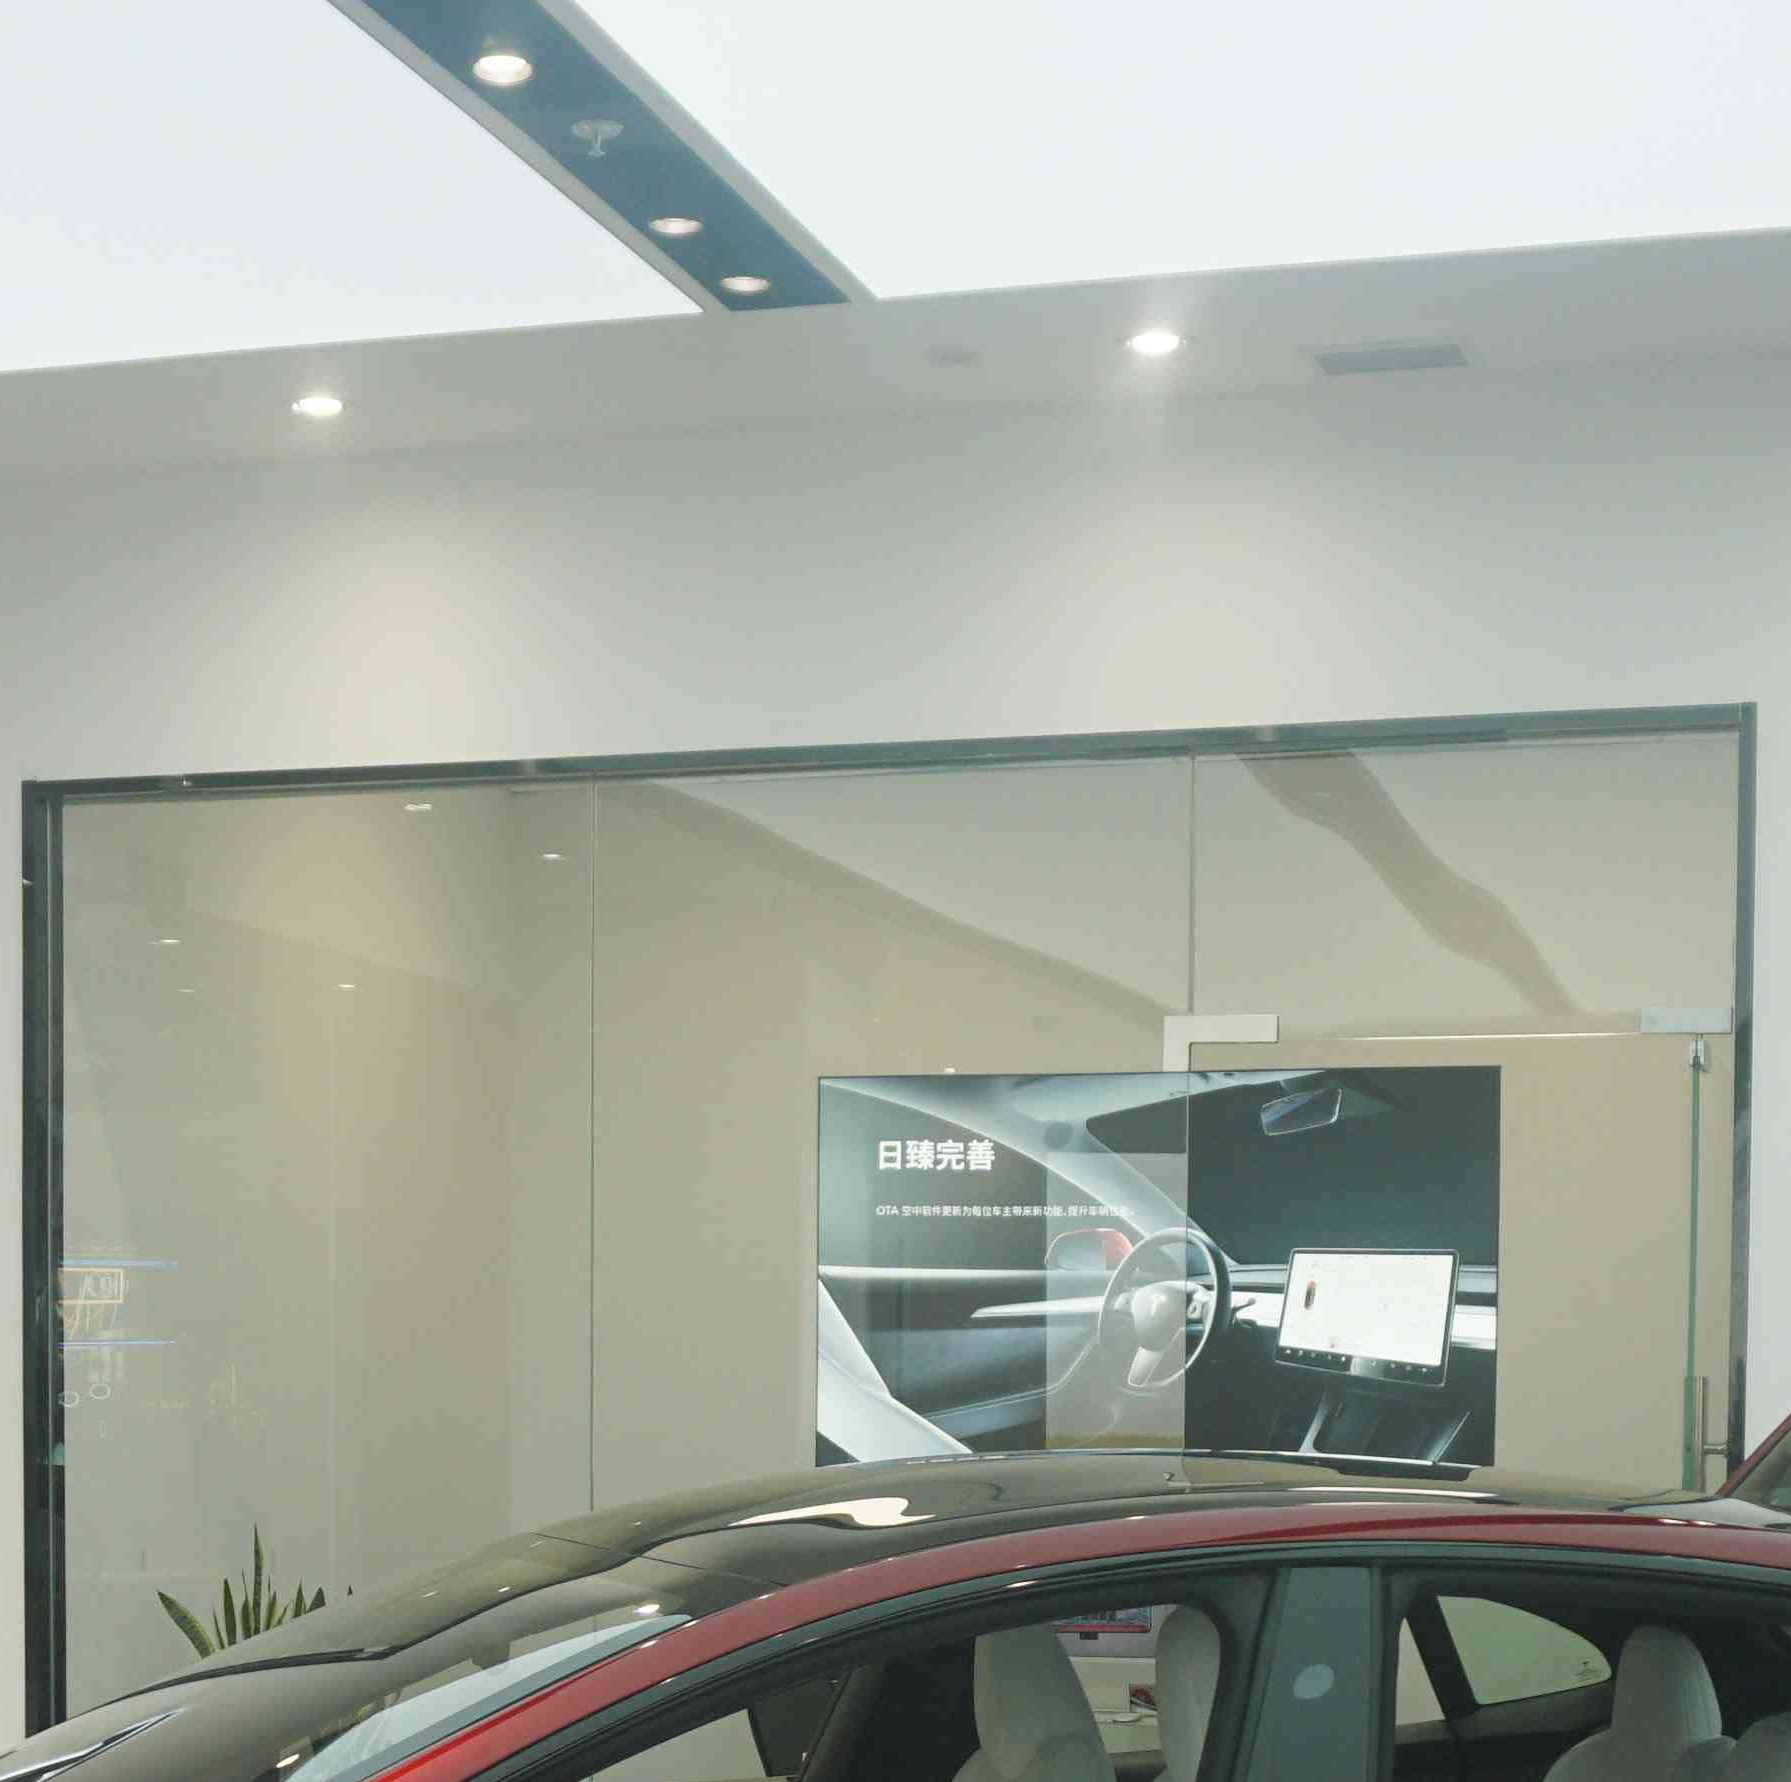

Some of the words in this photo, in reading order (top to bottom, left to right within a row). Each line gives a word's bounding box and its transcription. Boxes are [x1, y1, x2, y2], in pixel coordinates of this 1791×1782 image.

[878, 1139, 995, 1170] 日臻完善
[876, 1206, 898, 1216] OTA
